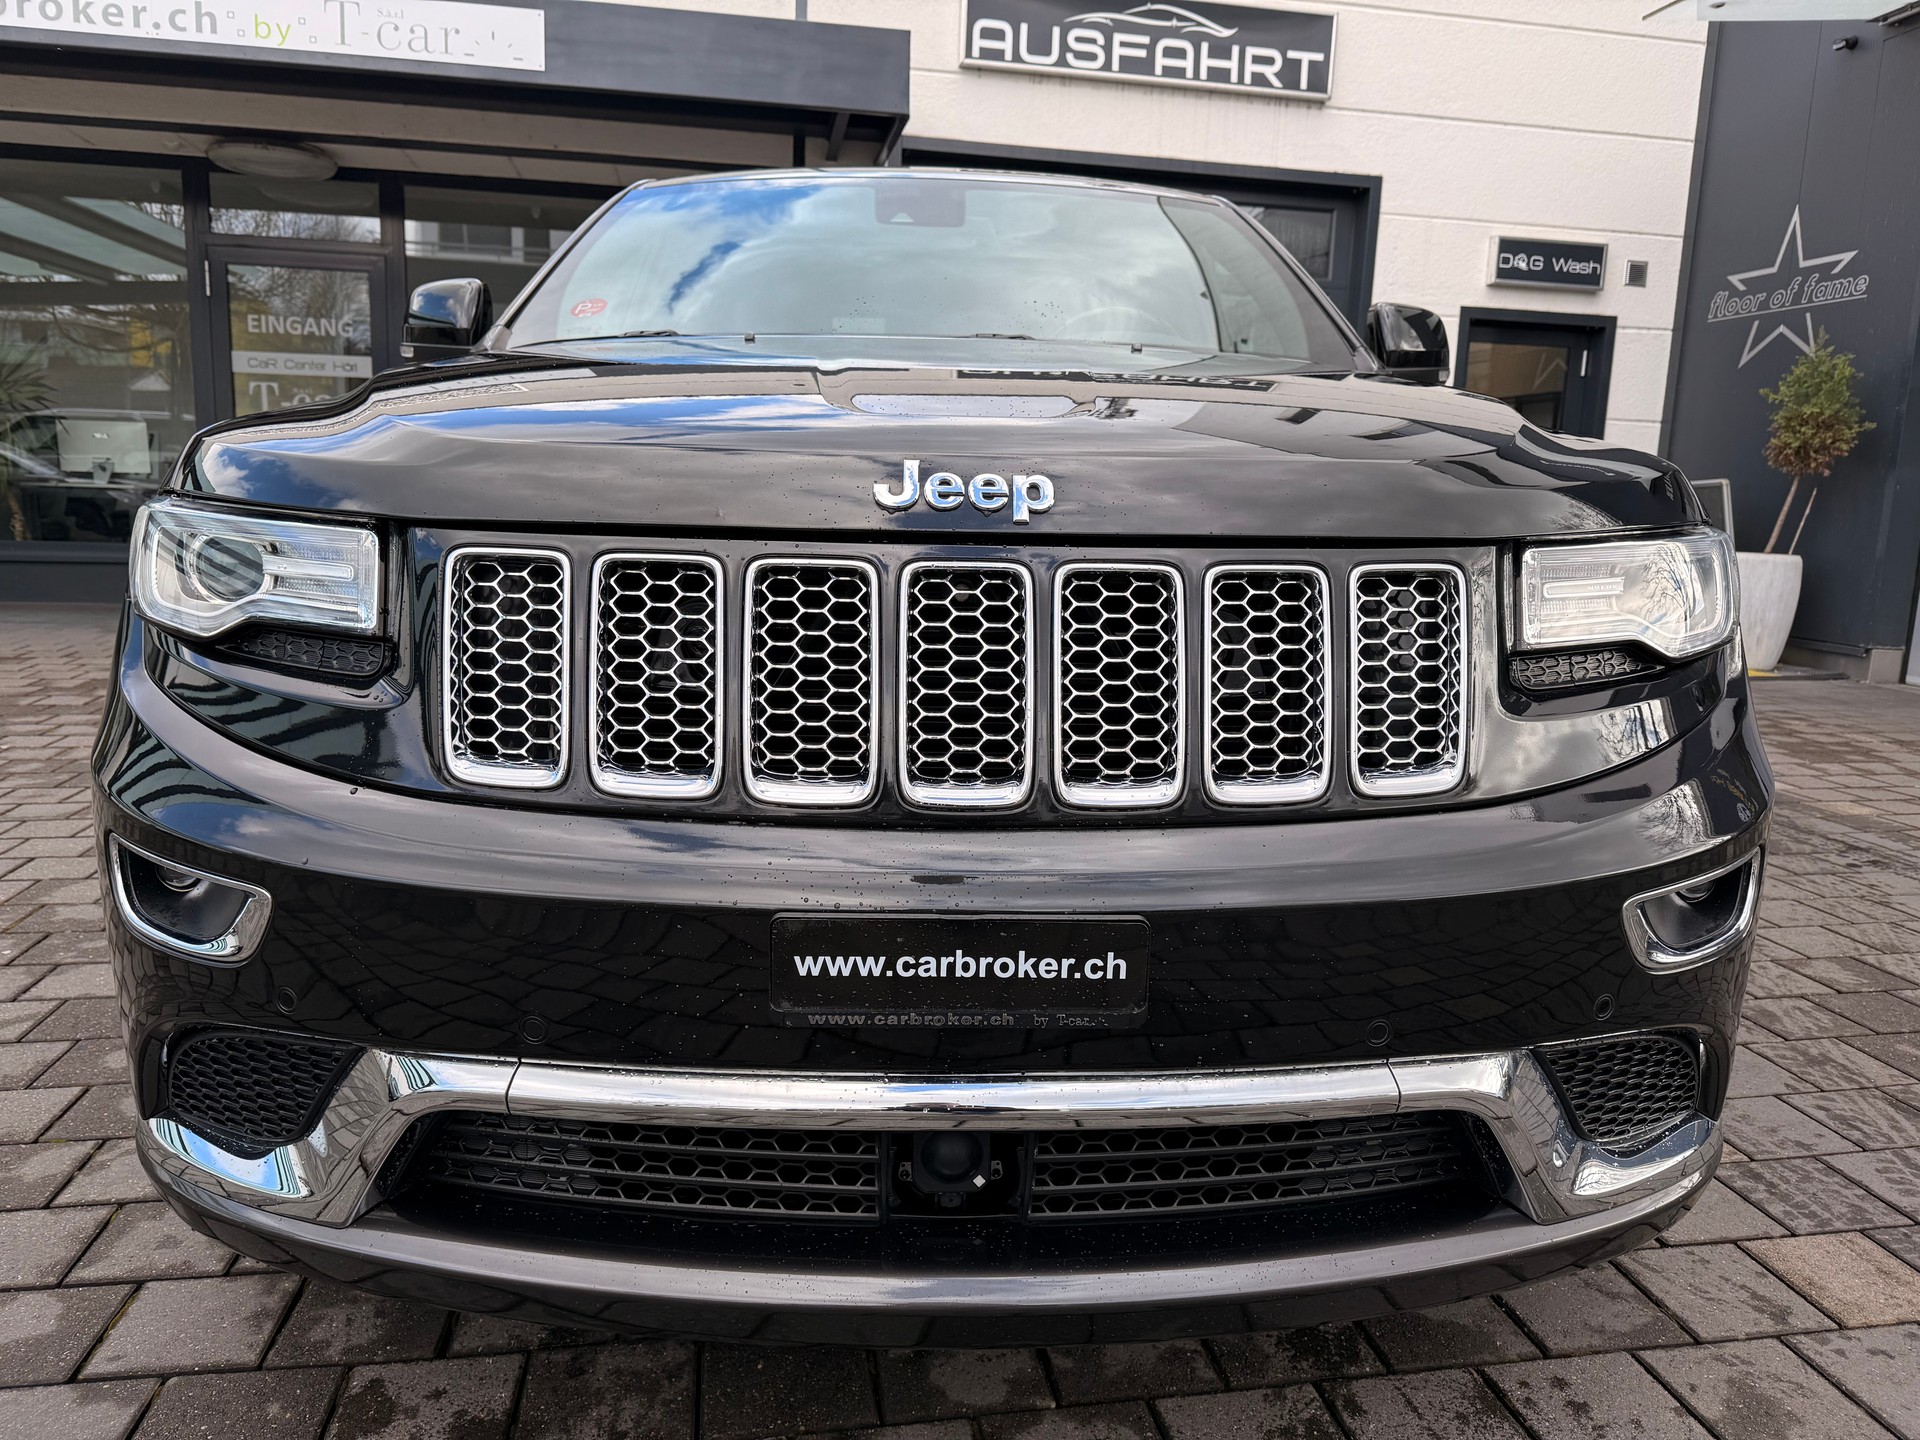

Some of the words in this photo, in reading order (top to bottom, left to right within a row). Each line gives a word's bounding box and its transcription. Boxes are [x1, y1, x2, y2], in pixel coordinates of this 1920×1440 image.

[0, 0, 218, 35] roker.ch
[254, 14, 291, 46] by
[324, 0, 460, 55] T-car
[971, 18, 1325, 90] AUSFAHRT
[1552, 257, 1600, 275] Wash
[1708, 291, 1767, 318] floor
[1769, 277, 1802, 308] of
[1801, 273, 1869, 304] fame
[247, 314, 354, 337] EINGANG
[284, 359, 327, 371] Center
[873, 459, 1055, 525] Jeep
[794, 950, 1127, 979] www.carbroker.ch
[808, 1013, 1014, 1026] www.carbroker.ch
[1033, 1014, 1049, 1028] by
